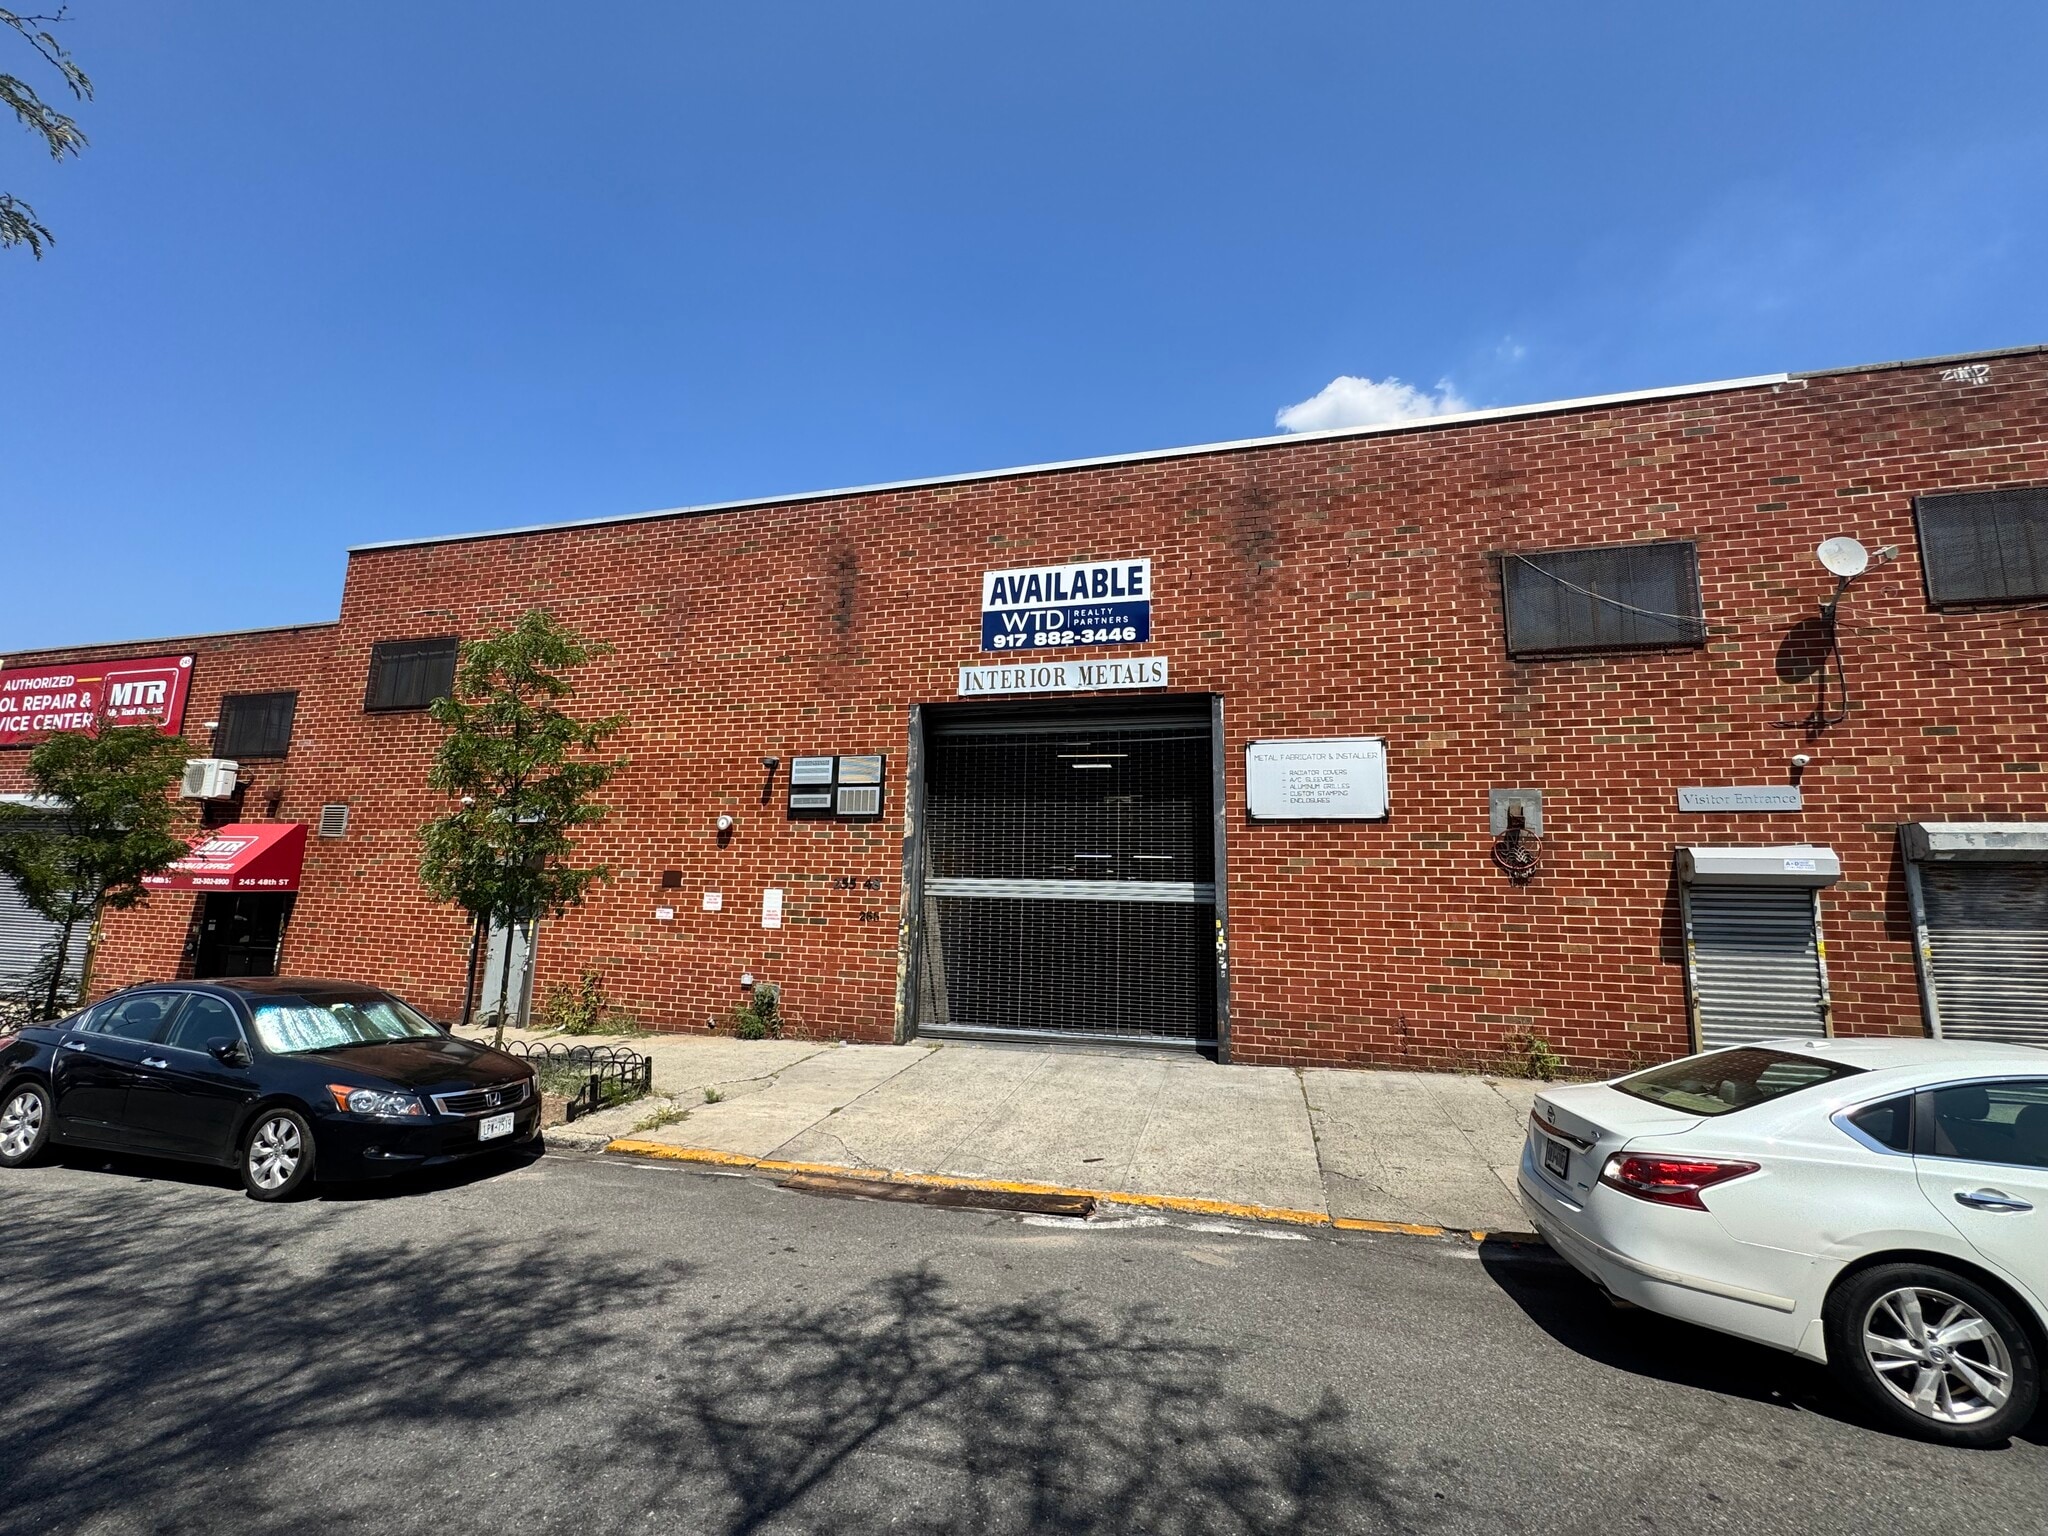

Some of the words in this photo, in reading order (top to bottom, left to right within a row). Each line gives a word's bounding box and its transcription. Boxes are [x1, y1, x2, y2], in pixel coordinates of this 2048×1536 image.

[989, 565, 1144, 606] AVAILABLE
[1001, 609, 1065, 633] WTD
[1073, 607, 1114, 617] REALTY
[1073, 615, 1130, 626] PARTNERS
[993, 633, 1028, 648] 917
[1033, 626, 1137, 646] 882-3446
[3, 675, 75, 691] AUTHORIZED
[964, 667, 1067, 691] INTERIOR
[1078, 661, 1163, 687] METALS
[22, 693, 77, 711] REPAIR
[80, 692, 91, 708] &
[109, 680, 167, 706] MTR
[33, 712, 94, 730] CENTER
[1254, 753, 1278, 762] METAL
[1280, 752, 1326, 761] FABRICATOR
[1335, 751, 1378, 760] INSTALLER
[1682, 793, 1730, 805] Visitor
[1734, 792, 1798, 804] Entrance
[239, 878, 256, 886] 245
[257, 878, 277, 886] 48th
[278, 878, 290, 886] ST
